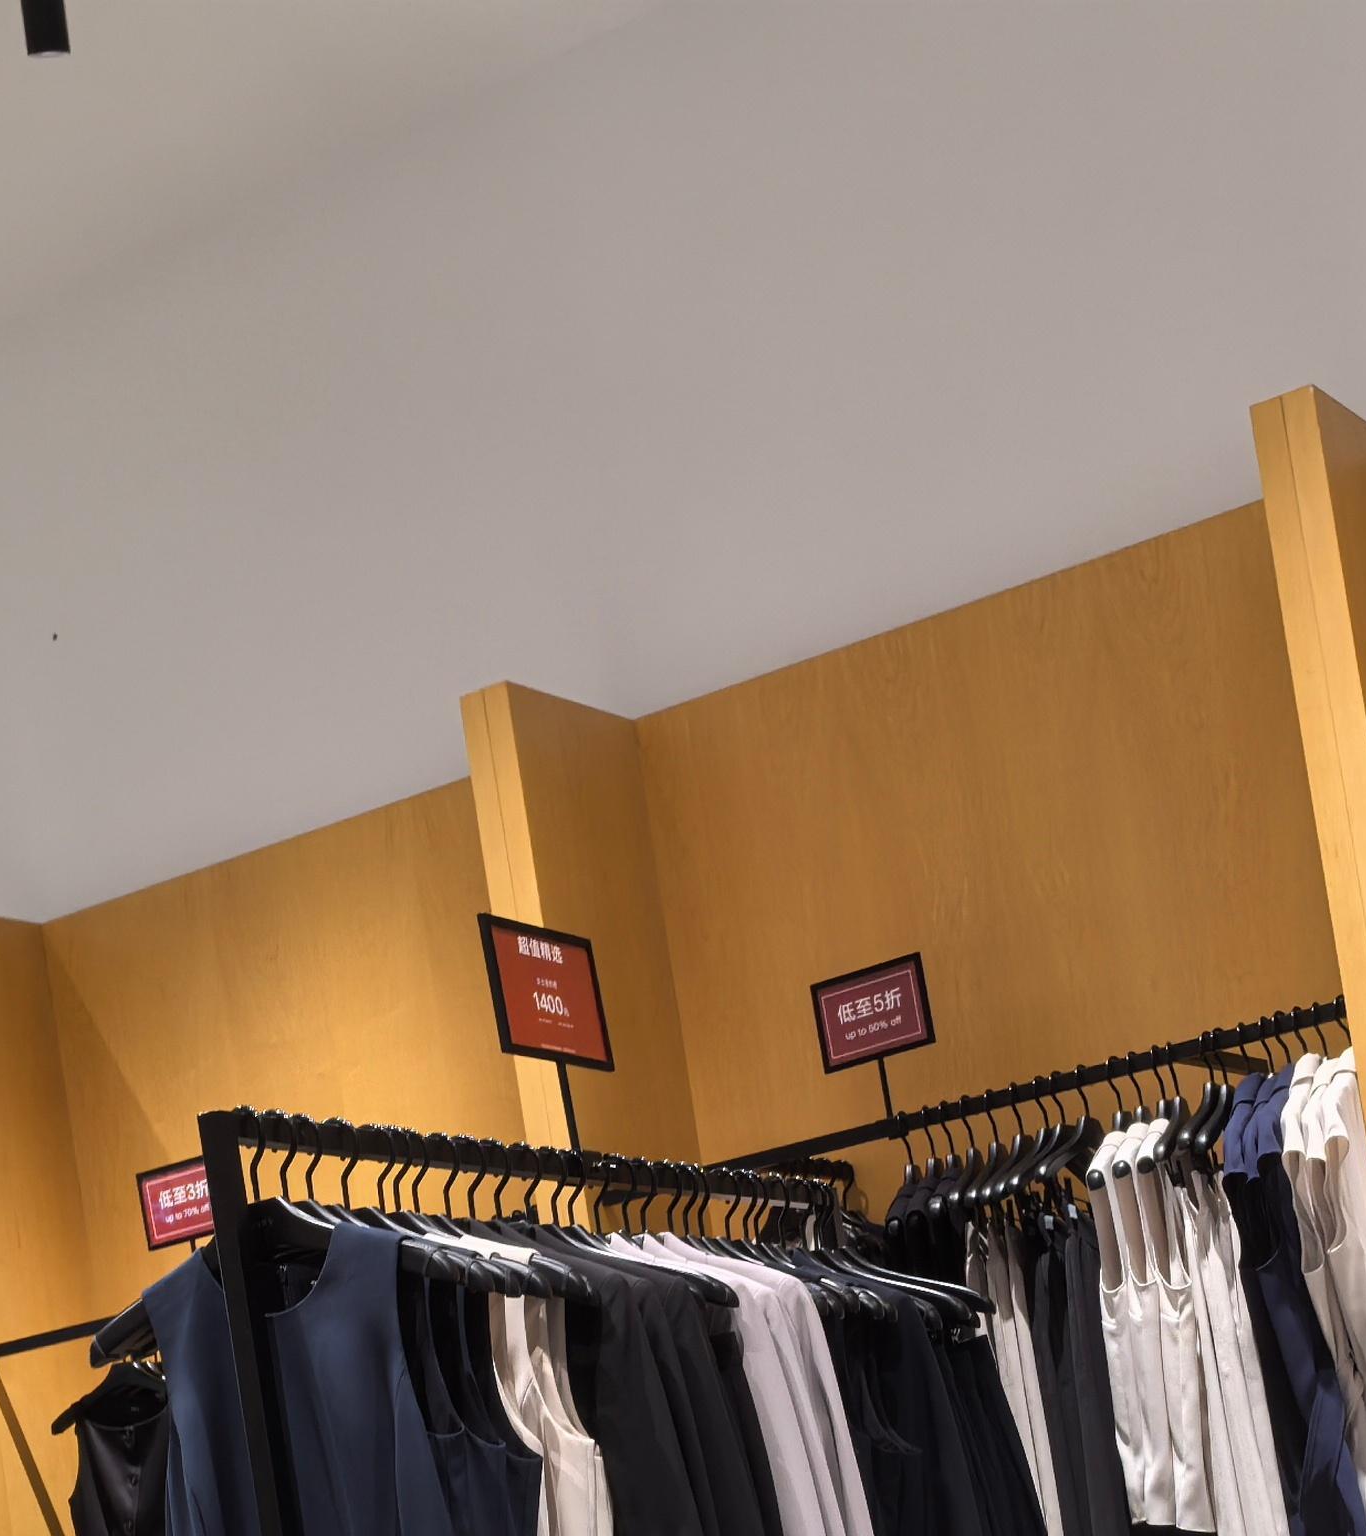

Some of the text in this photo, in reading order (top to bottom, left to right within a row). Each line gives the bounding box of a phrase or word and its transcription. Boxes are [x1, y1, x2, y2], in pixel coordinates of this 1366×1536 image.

[517, 935, 563, 964] 超值精选
[837, 987, 902, 1025] 低至5折
[845, 1031, 856, 1040] up
[858, 1028, 867, 1036] to
[890, 1015, 902, 1026] off
[159, 1178, 209, 1210] 低至3折
[165, 1214, 174, 1224] up
